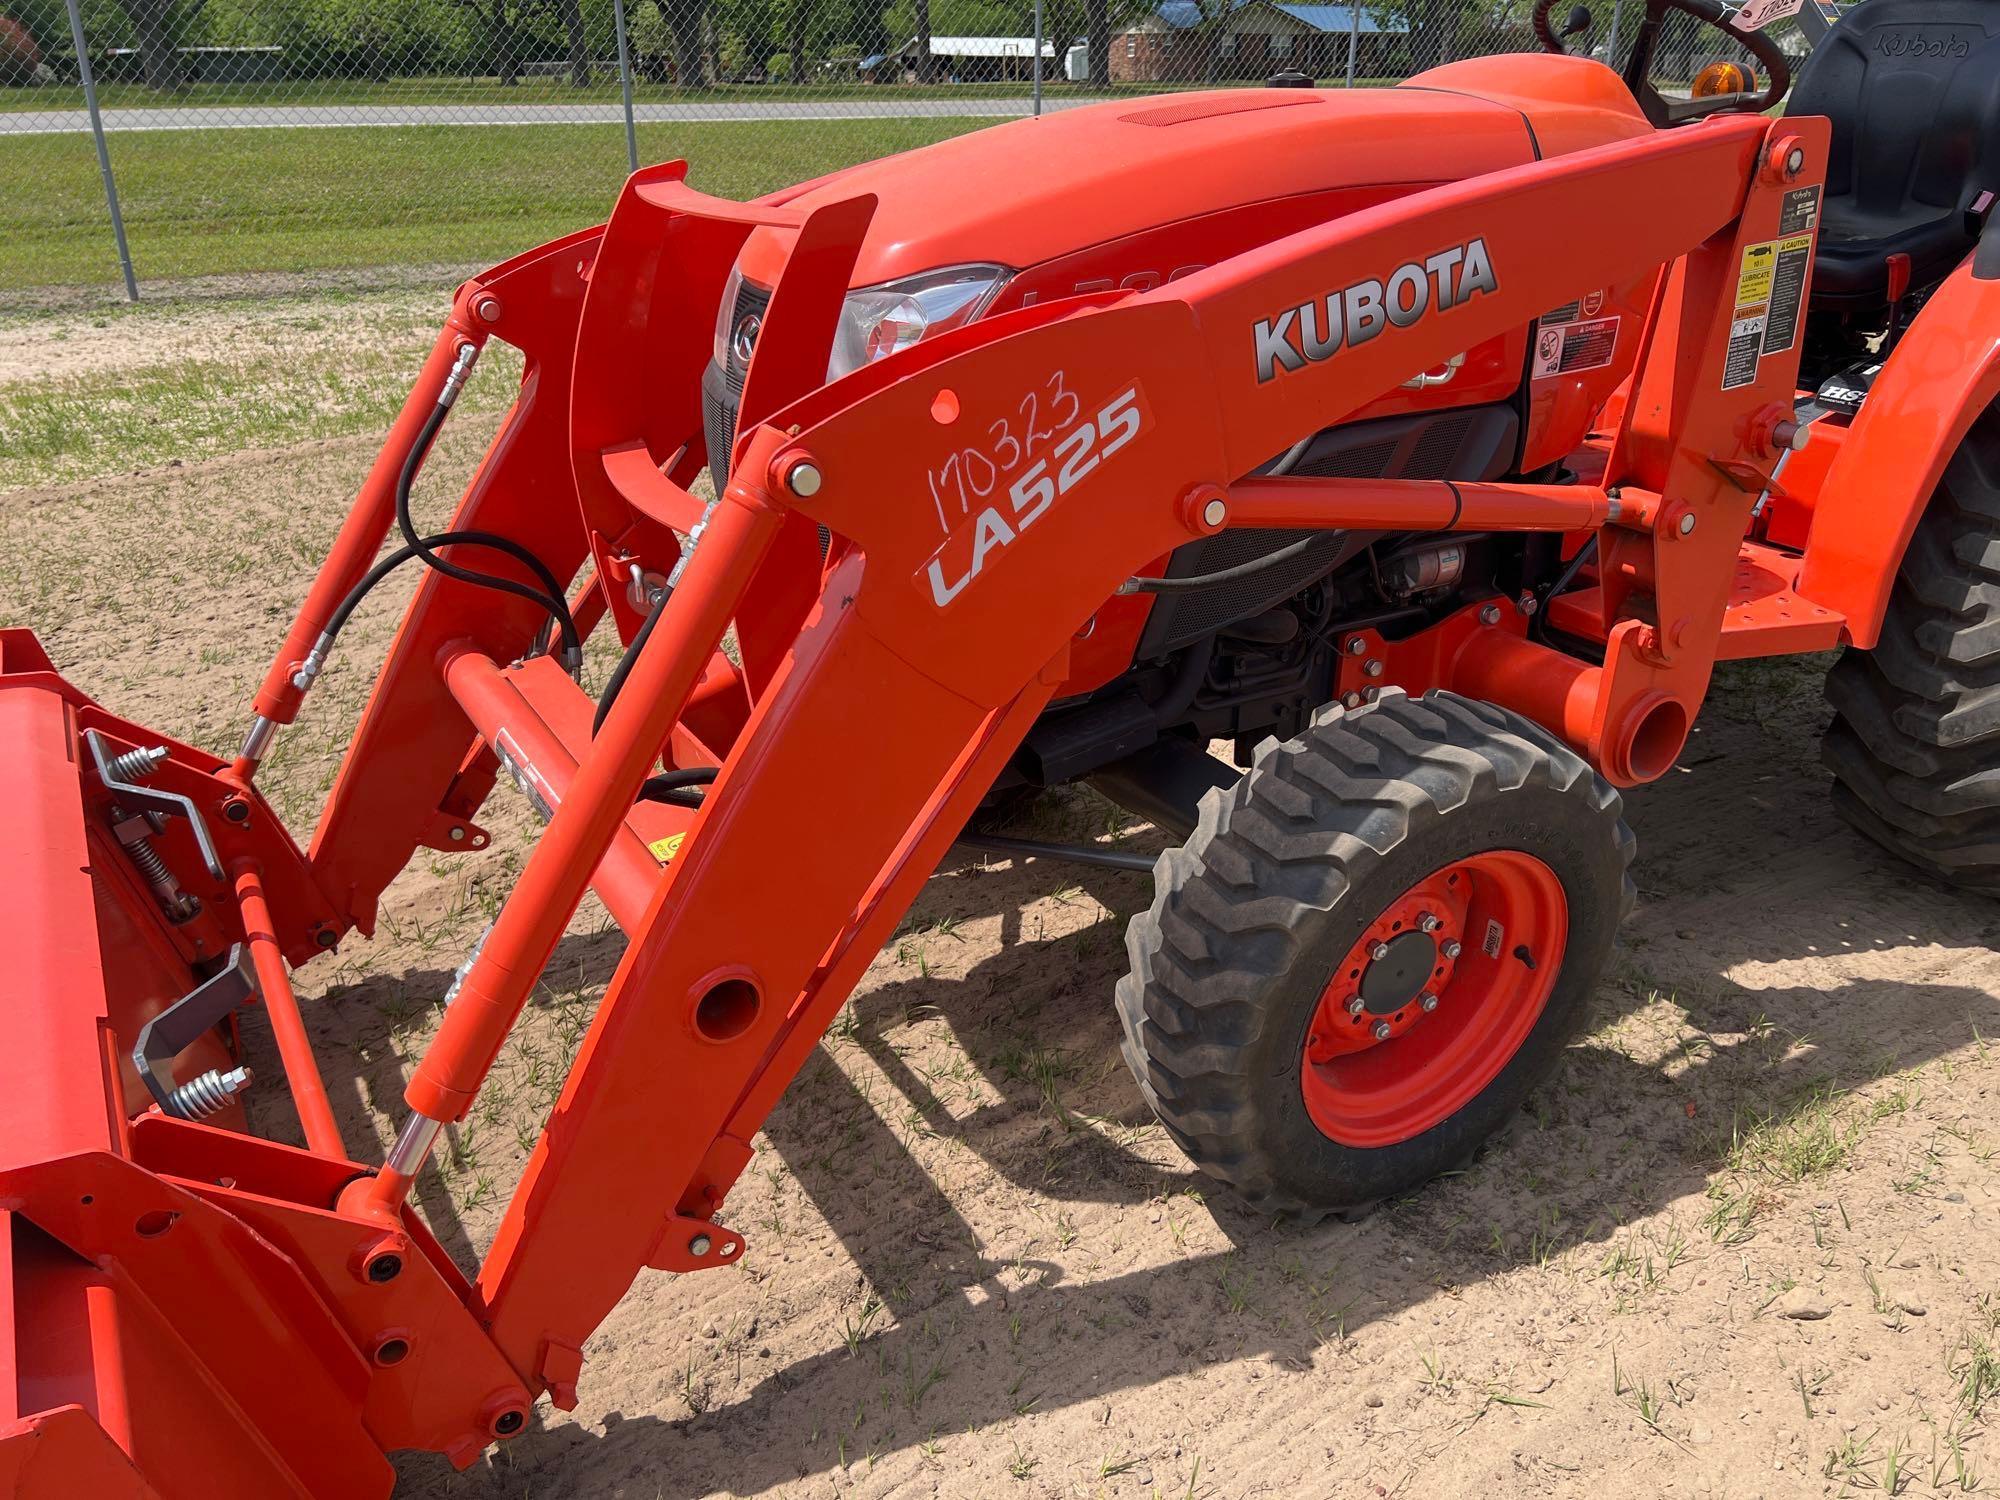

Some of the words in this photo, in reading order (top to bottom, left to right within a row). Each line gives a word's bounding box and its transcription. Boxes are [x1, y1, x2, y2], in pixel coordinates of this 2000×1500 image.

[1872, 33, 1969, 57] Kubota
[1253, 237, 1498, 384] KUBOTA
[1742, 271, 1770, 283] LUBRICATE
[926, 387, 1141, 608] LA525
[927, 369, 1080, 534] 170323
